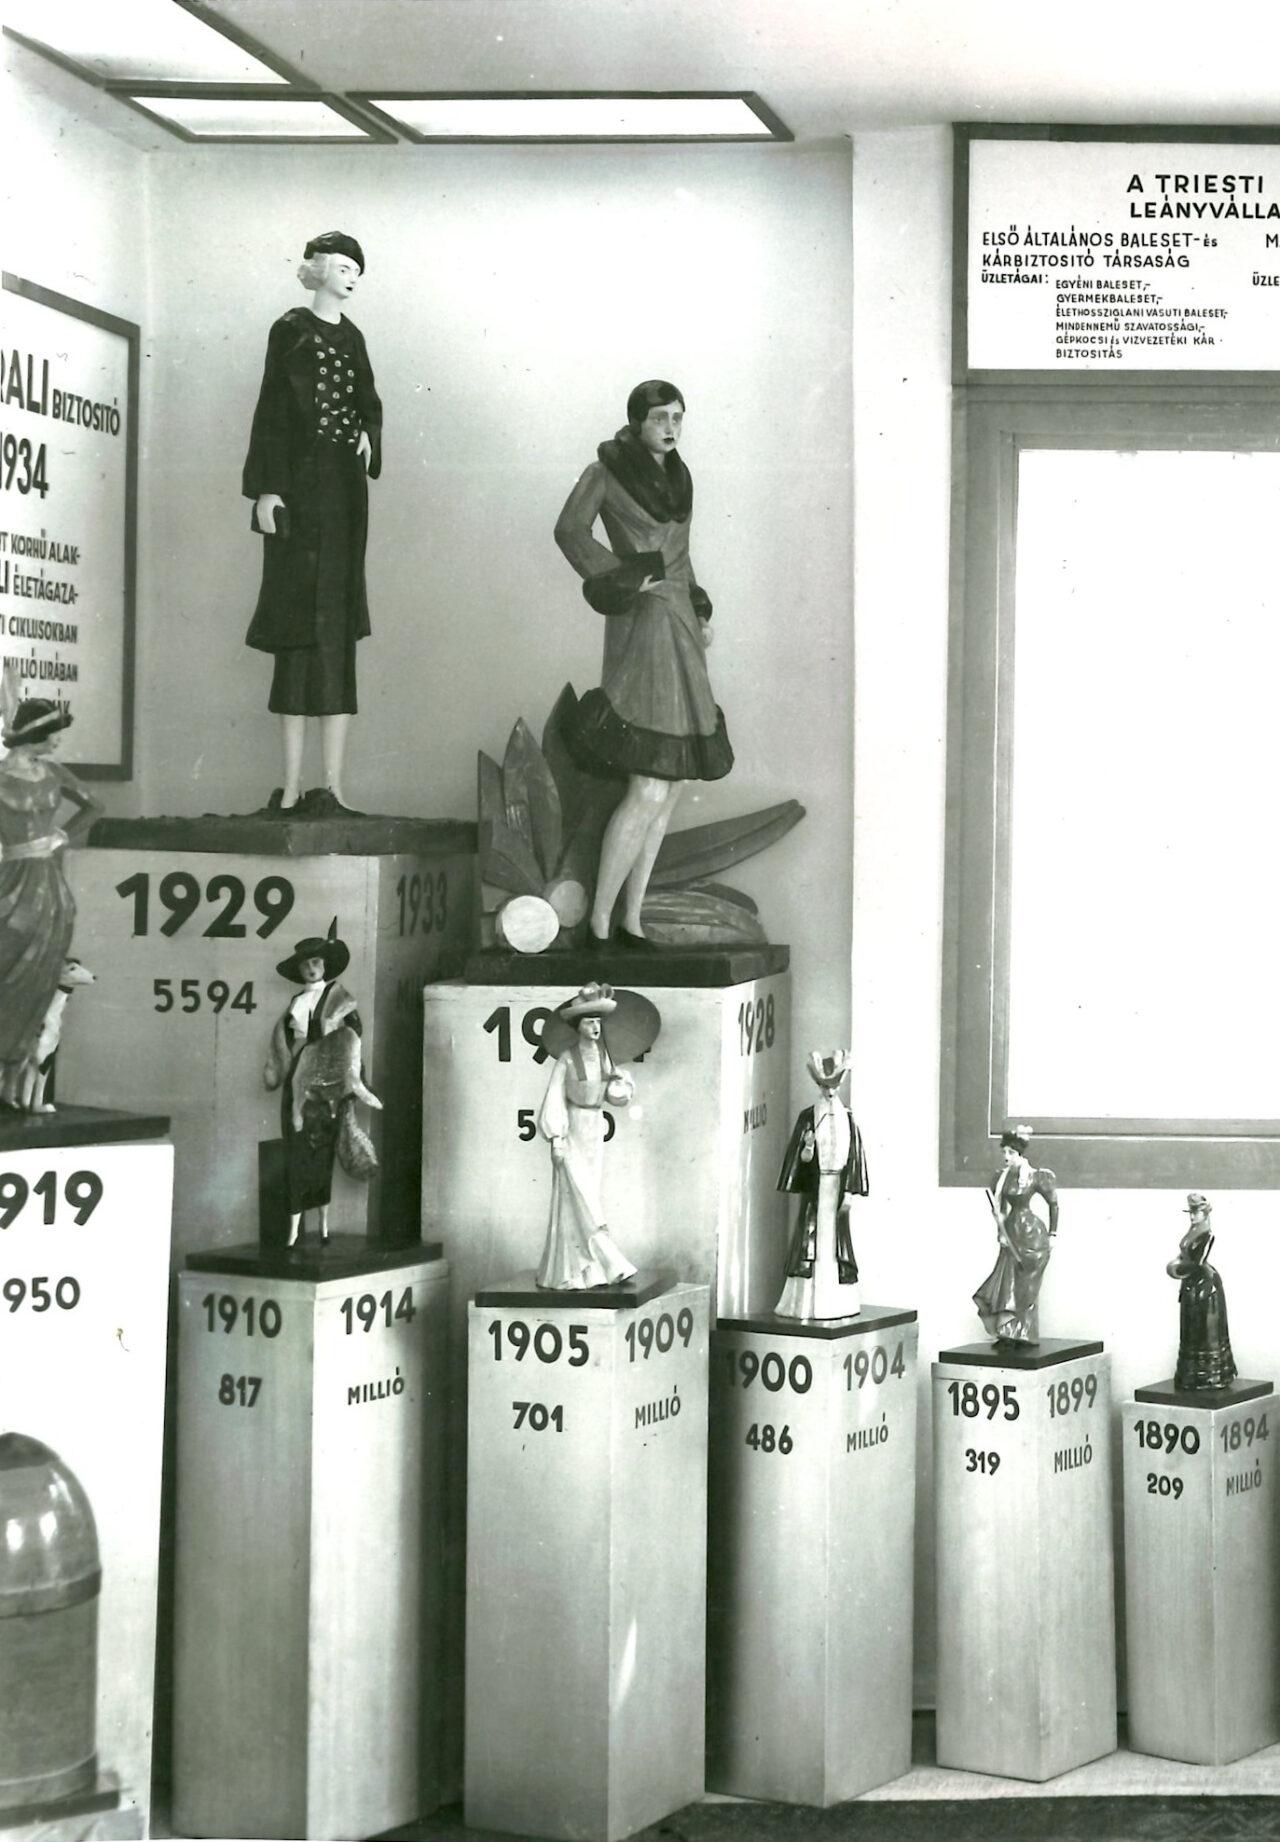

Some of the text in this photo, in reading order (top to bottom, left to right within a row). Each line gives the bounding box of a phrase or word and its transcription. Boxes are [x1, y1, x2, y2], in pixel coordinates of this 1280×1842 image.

[1127, 174, 1144, 193] A
[1155, 174, 1264, 193] TRIESTI
[1023, 225, 1114, 247] ÁLTALÁNOS
[982, 248, 1189, 268] KÁRBIZTOSITÓ TÁRSASÁG
[1056, 275, 1093, 289] EGYÉNI
[1146, 308, 1181, 317] VASUTI
[1056, 345, 1122, 358] BIZTOSITÁS
[52, 388, 120, 436] BIZTOSITÓ
[8, 616, 79, 644] CIKLUSOKBAN
[39, 652, 79, 682] LIRÁBAN
[116, 872, 448, 939] 1929 1933
[154, 979, 257, 1015] 5594
[737, 994, 775, 1057] 1928
[202, 1287, 416, 1338] 1910 1914
[488, 1307, 694, 1367] 1905 1909
[219, 1367, 404, 1408] 817 MILLIÓ
[843, 1345, 906, 1392] 1904
[512, 1385, 682, 1432] 701 MILLIÓ
[948, 1374, 1098, 1421] 1895 1899
[745, 1412, 889, 1455] 486 MILLIÓ
[1134, 1414, 1270, 1455] 1890 1894
[966, 1434, 1092, 1475] 319 MILLIÓ
[1147, 1458, 1262, 1500] 209 MILLIÓ
